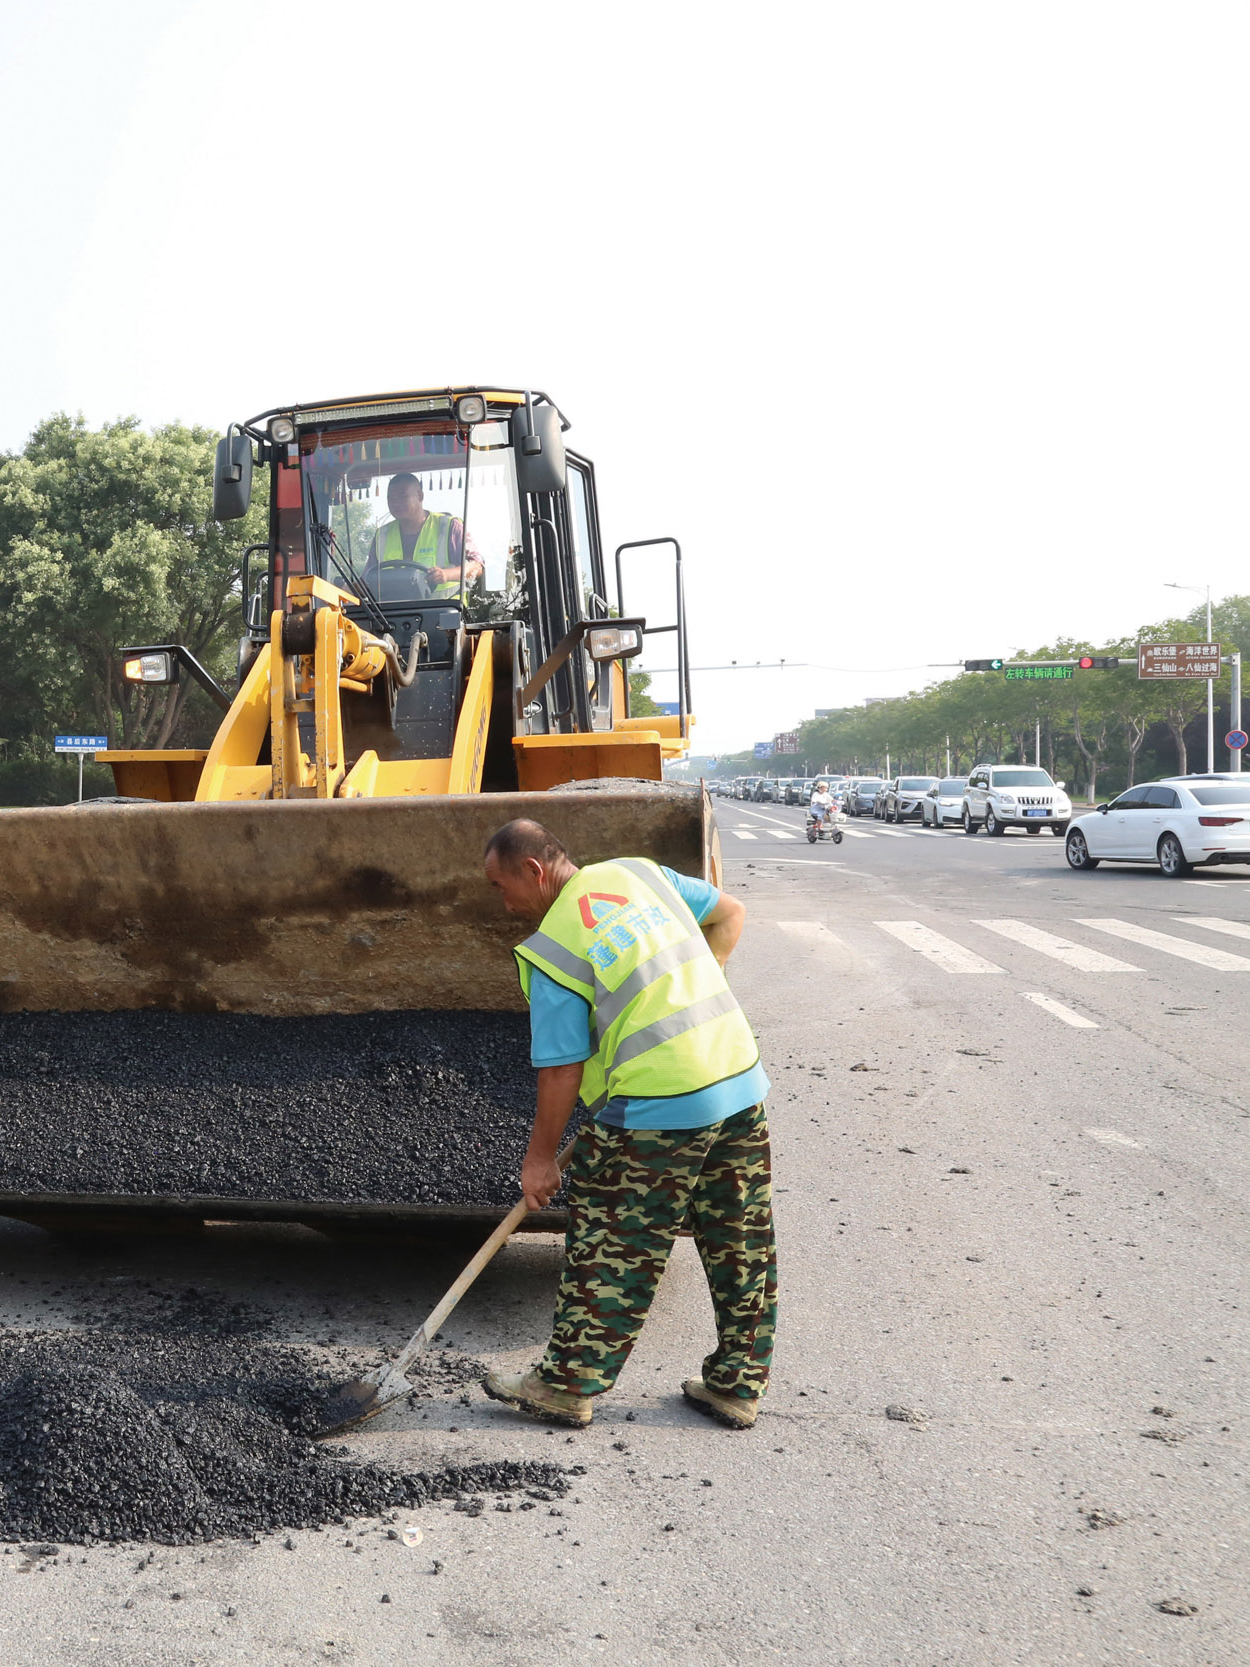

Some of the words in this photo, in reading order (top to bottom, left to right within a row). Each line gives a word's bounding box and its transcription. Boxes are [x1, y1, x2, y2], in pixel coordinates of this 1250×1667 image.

[1153, 646, 1177, 656] 欧乐堡
[1186, 646, 1218, 656] 海洋世界
[1153, 663, 1177, 673] 三仙山
[1185, 662, 1218, 672] 八仙过海
[1005, 666, 1073, 680] 左转车辆请通行
[593, 902, 636, 934] PENGJIAN
[586, 904, 671, 971] 蓬建市政
